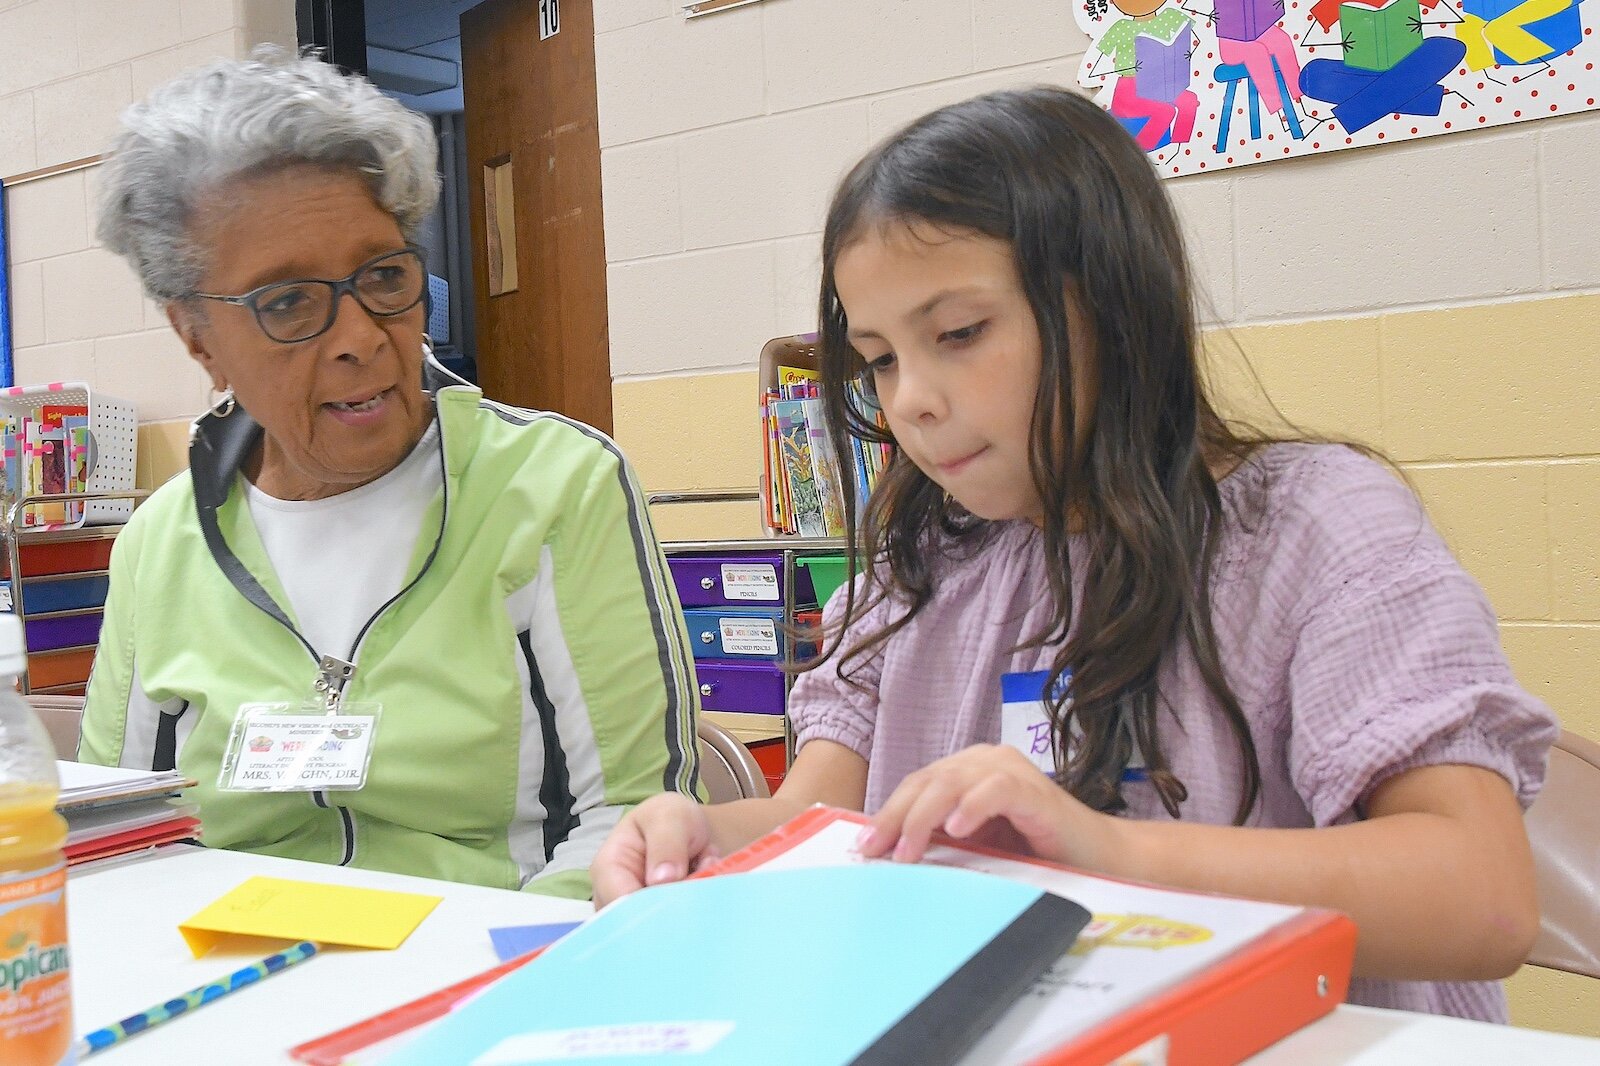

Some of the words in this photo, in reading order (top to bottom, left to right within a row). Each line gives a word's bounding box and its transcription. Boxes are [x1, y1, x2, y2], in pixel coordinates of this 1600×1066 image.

[541, 0, 558, 36] 10
[242, 771, 272, 780] MRS.
[277, 770, 333, 780] VGHN,
[336, 769, 360, 779] DIR.
